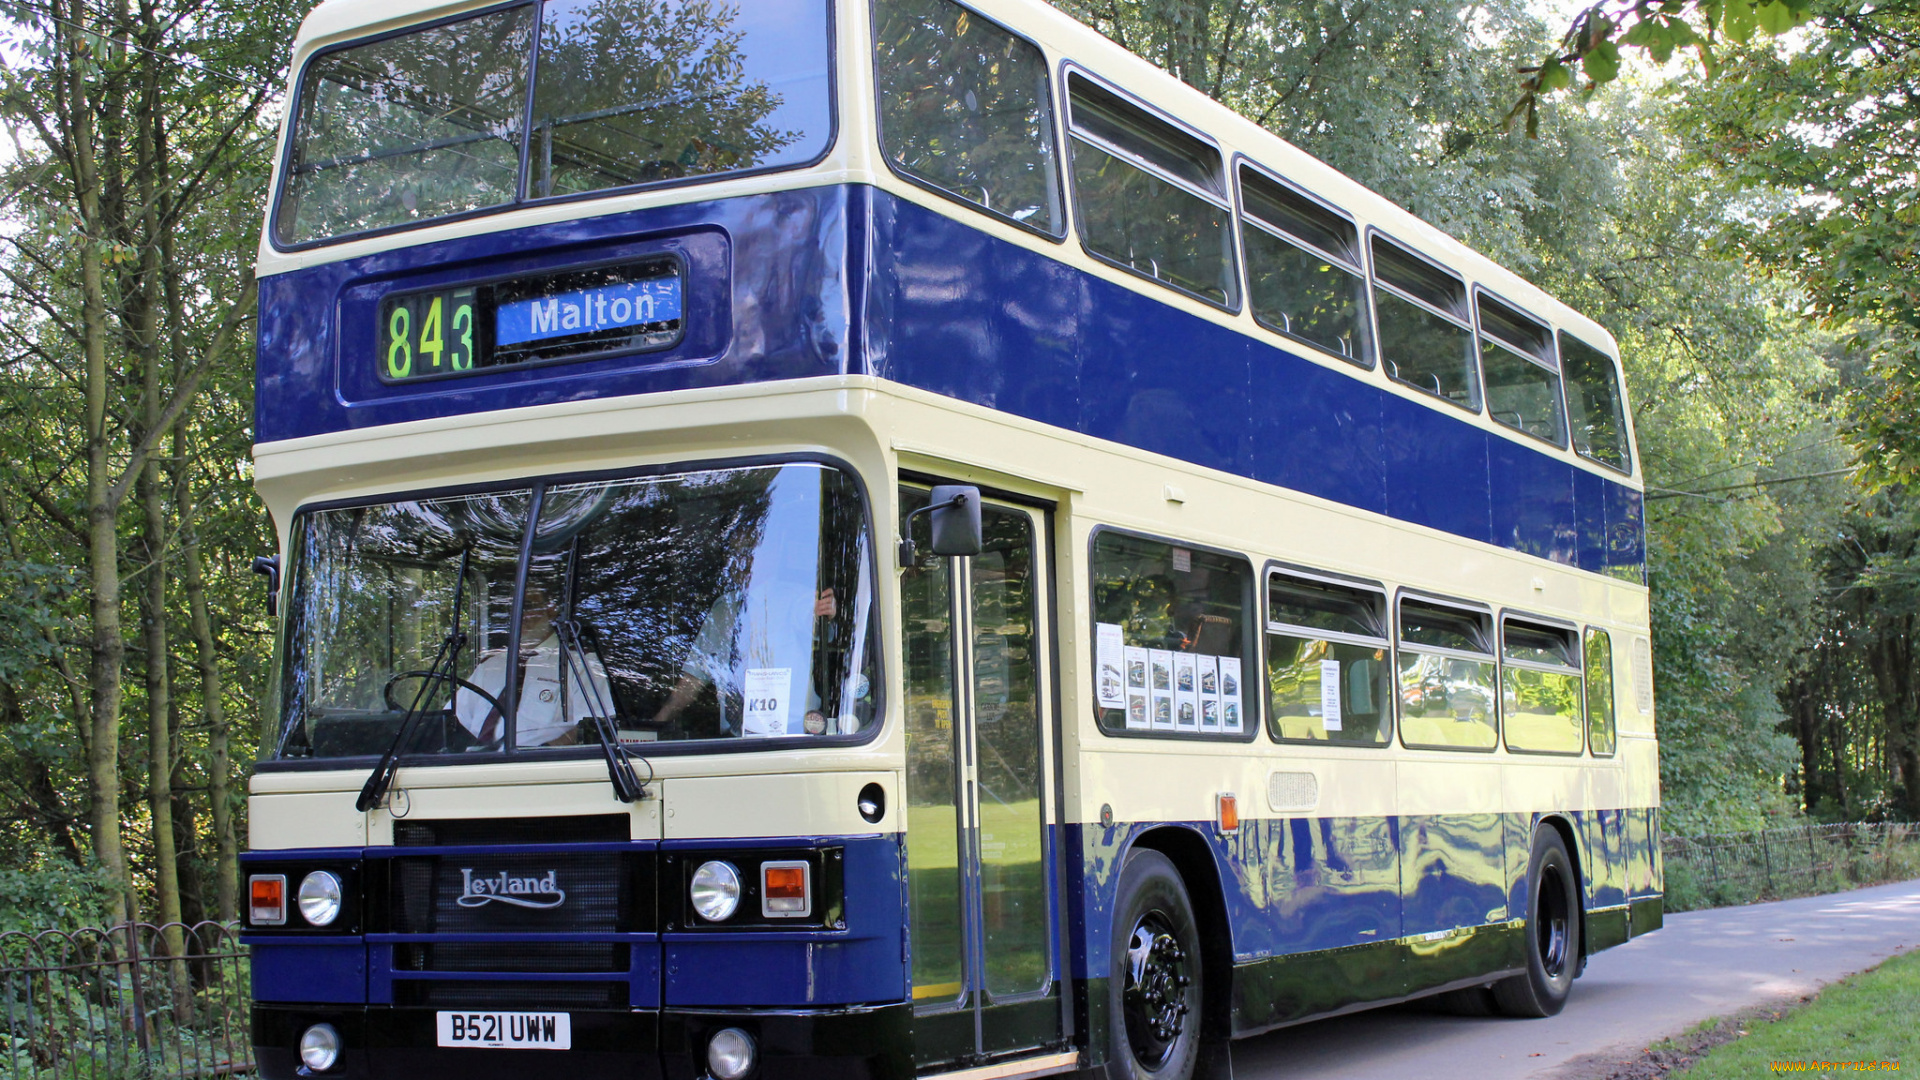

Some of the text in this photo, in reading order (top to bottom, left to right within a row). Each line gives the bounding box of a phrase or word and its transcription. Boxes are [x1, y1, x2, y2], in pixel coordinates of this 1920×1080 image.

[388, 293, 655, 379] 843 Malton
[749, 698, 778, 712] K10
[457, 868, 566, 909] Leyland
[452, 1014, 556, 1042] B521 UWW
